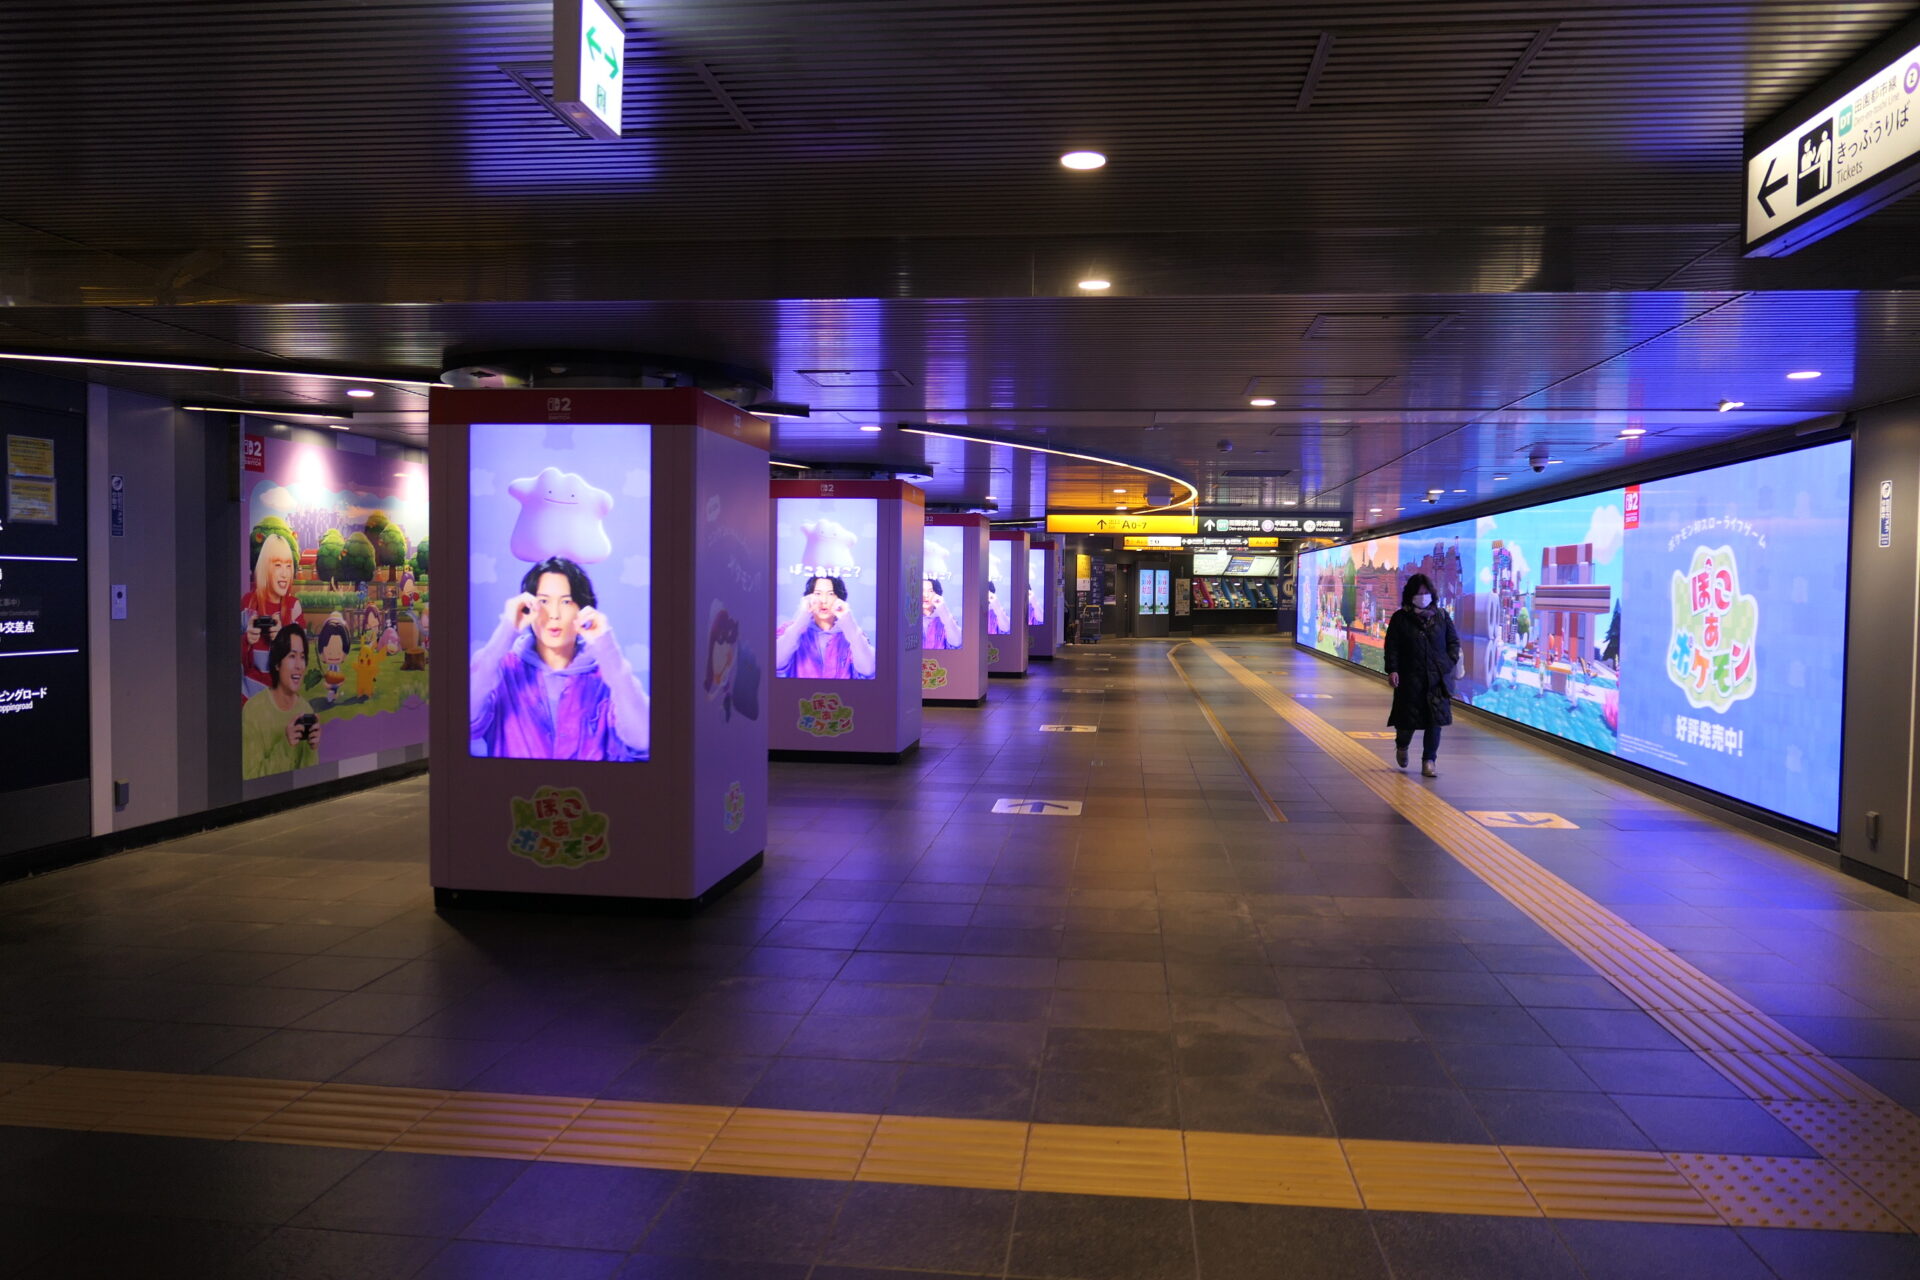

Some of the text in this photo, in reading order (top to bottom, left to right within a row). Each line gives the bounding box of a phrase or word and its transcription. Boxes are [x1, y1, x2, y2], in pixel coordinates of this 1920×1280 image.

[1837, 100, 1911, 165] きっぷうりば
[1840, 112, 1852, 131] DT
[1837, 161, 1863, 184] Tickets
[1691, 558, 1733, 613] ぽこ
[1704, 612, 1720, 648] あ
[1671, 633, 1751, 694] ポケモン
[1675, 714, 1744, 758] 好評発売中!
[513, 829, 604, 859] ポケモン
